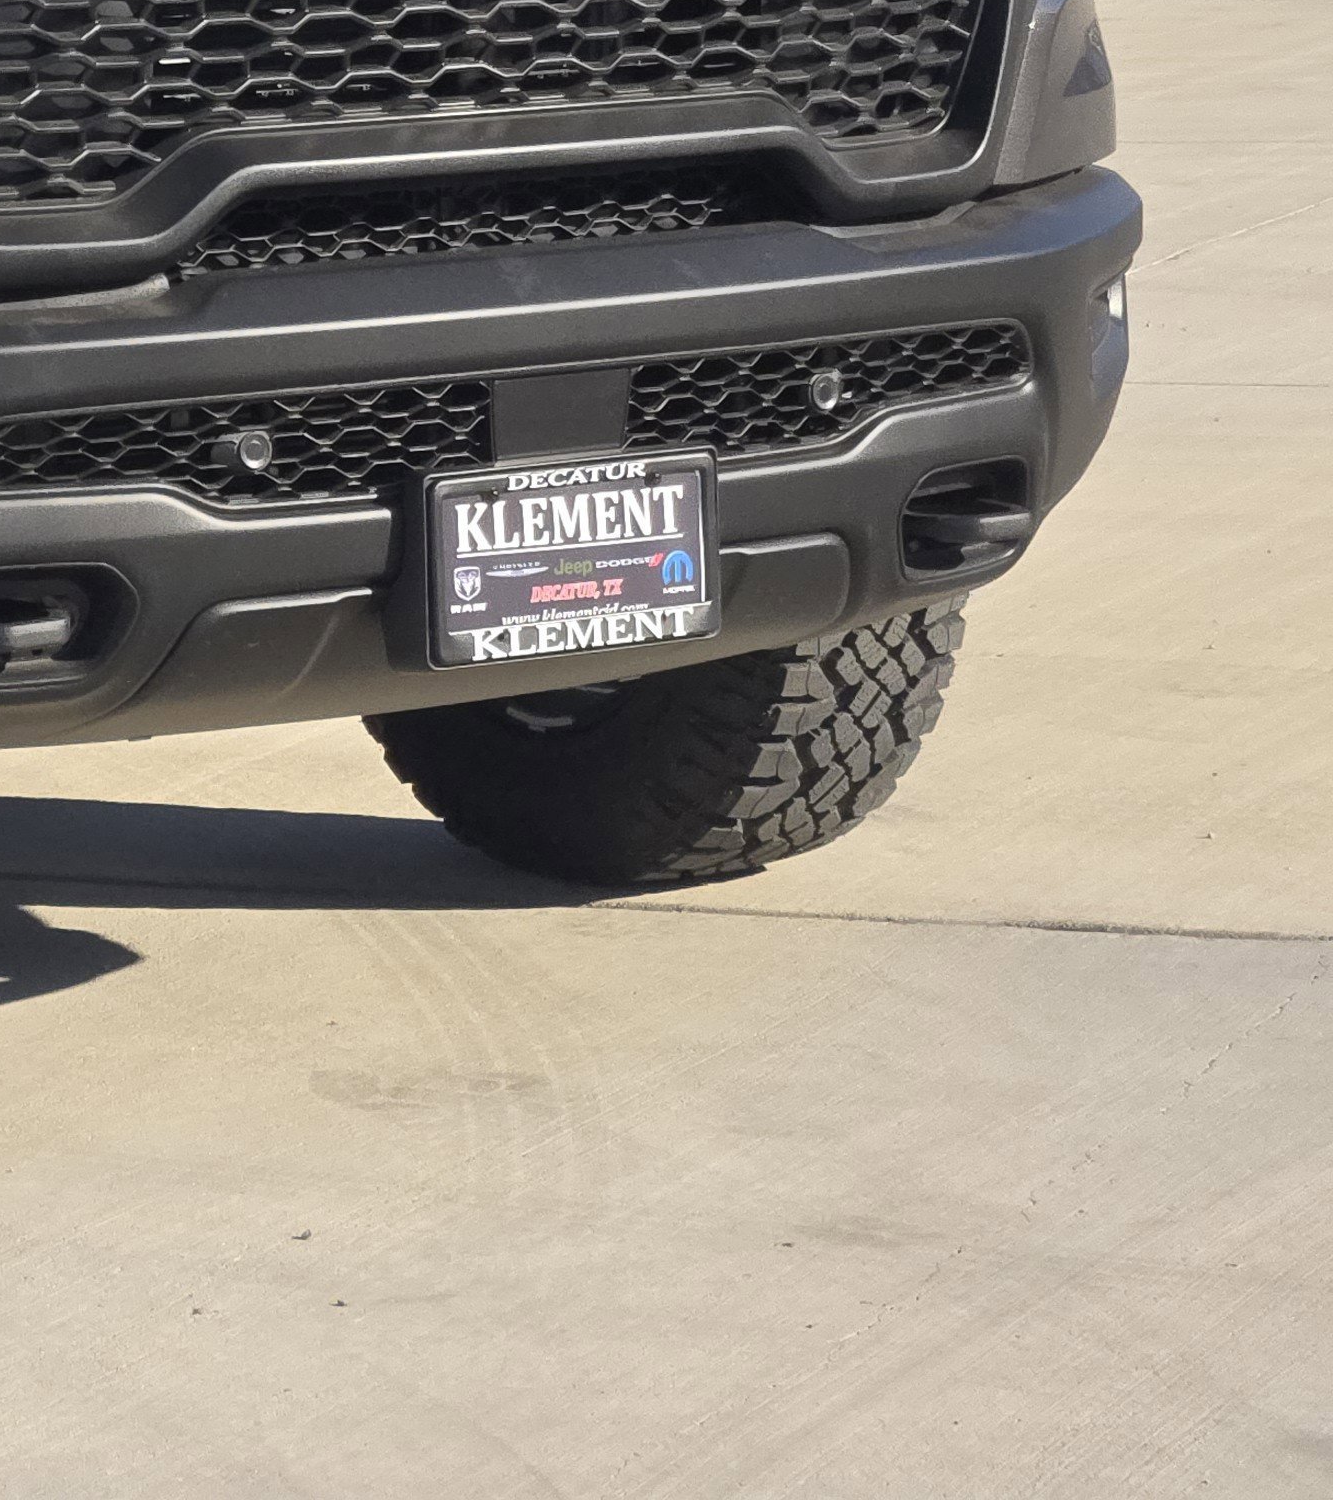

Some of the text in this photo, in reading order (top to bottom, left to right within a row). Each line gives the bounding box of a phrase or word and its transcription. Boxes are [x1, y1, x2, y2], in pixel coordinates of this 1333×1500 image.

[507, 461, 647, 491] DECATUR
[454, 485, 685, 553] KLEMENT
[554, 558, 593, 577] Jeep
[601, 578, 624, 597] TX
[450, 603, 489, 614] RAM
[471, 607, 695, 662] KLEMENT
